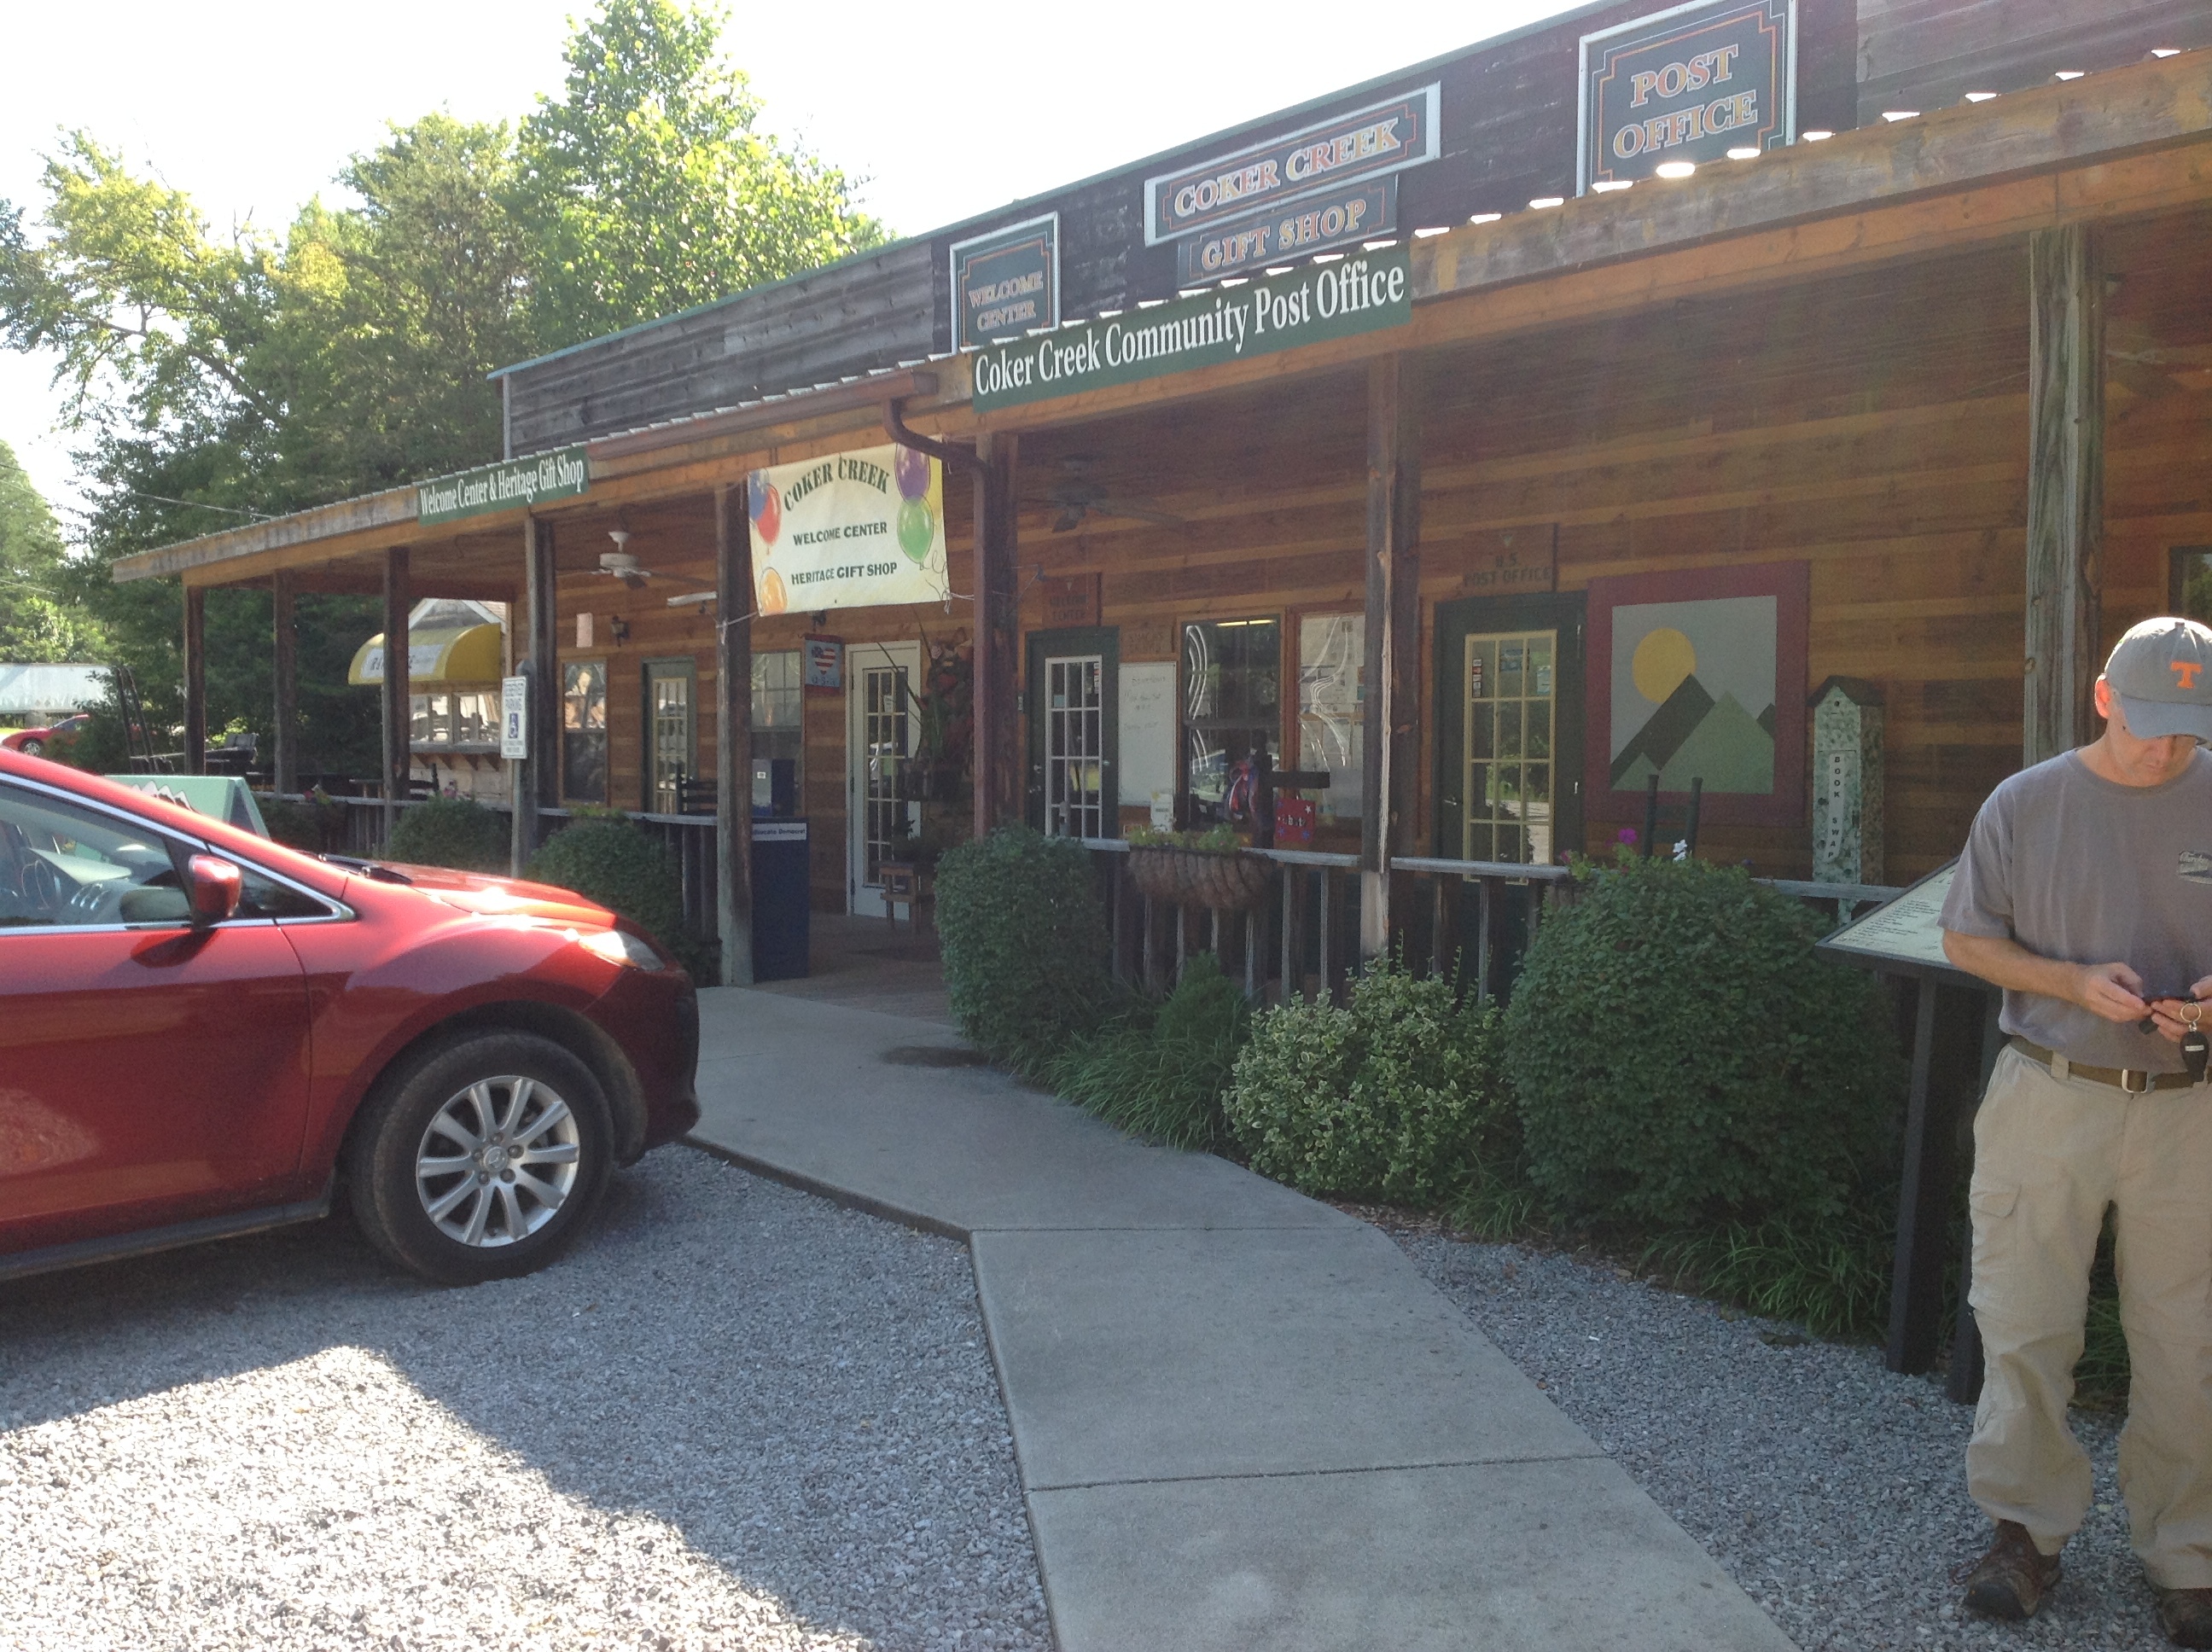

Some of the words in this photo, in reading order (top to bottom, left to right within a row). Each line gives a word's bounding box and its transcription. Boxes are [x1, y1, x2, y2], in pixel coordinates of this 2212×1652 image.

[1631, 44, 1738, 108] POST
[1613, 90, 1758, 159] OFFICE
[1174, 160, 1280, 218] COKER
[1285, 118, 1401, 182] CREEK
[1202, 225, 1270, 270] GIFT
[1278, 199, 1365, 250] SHOP
[968, 270, 1043, 307] WELCOME
[976, 301, 1036, 332] CENTER
[975, 353, 1034, 396] Coker
[1039, 332, 1101, 382] Creek
[1105, 300, 1249, 367] Community
[1254, 281, 1311, 334] Post
[1316, 259, 1406, 319] Office
[420, 485, 457, 515] Welcome
[457, 479, 488, 508] Center
[489, 473, 498, 502] &
[498, 467, 538, 503] Heritage
[538, 459, 557, 492] Gift
[556, 454, 584, 493] Shop
[783, 462, 835, 512] COKER
[837, 457, 890, 494] CREEK
[793, 527, 841, 546] WELCOME
[843, 521, 888, 538] CENTER
[791, 568, 835, 585] HERITAGE
[836, 565, 865, 579] GIFT
[866, 561, 898, 577] SHOP
[2170, 661, 2203, 689] T
